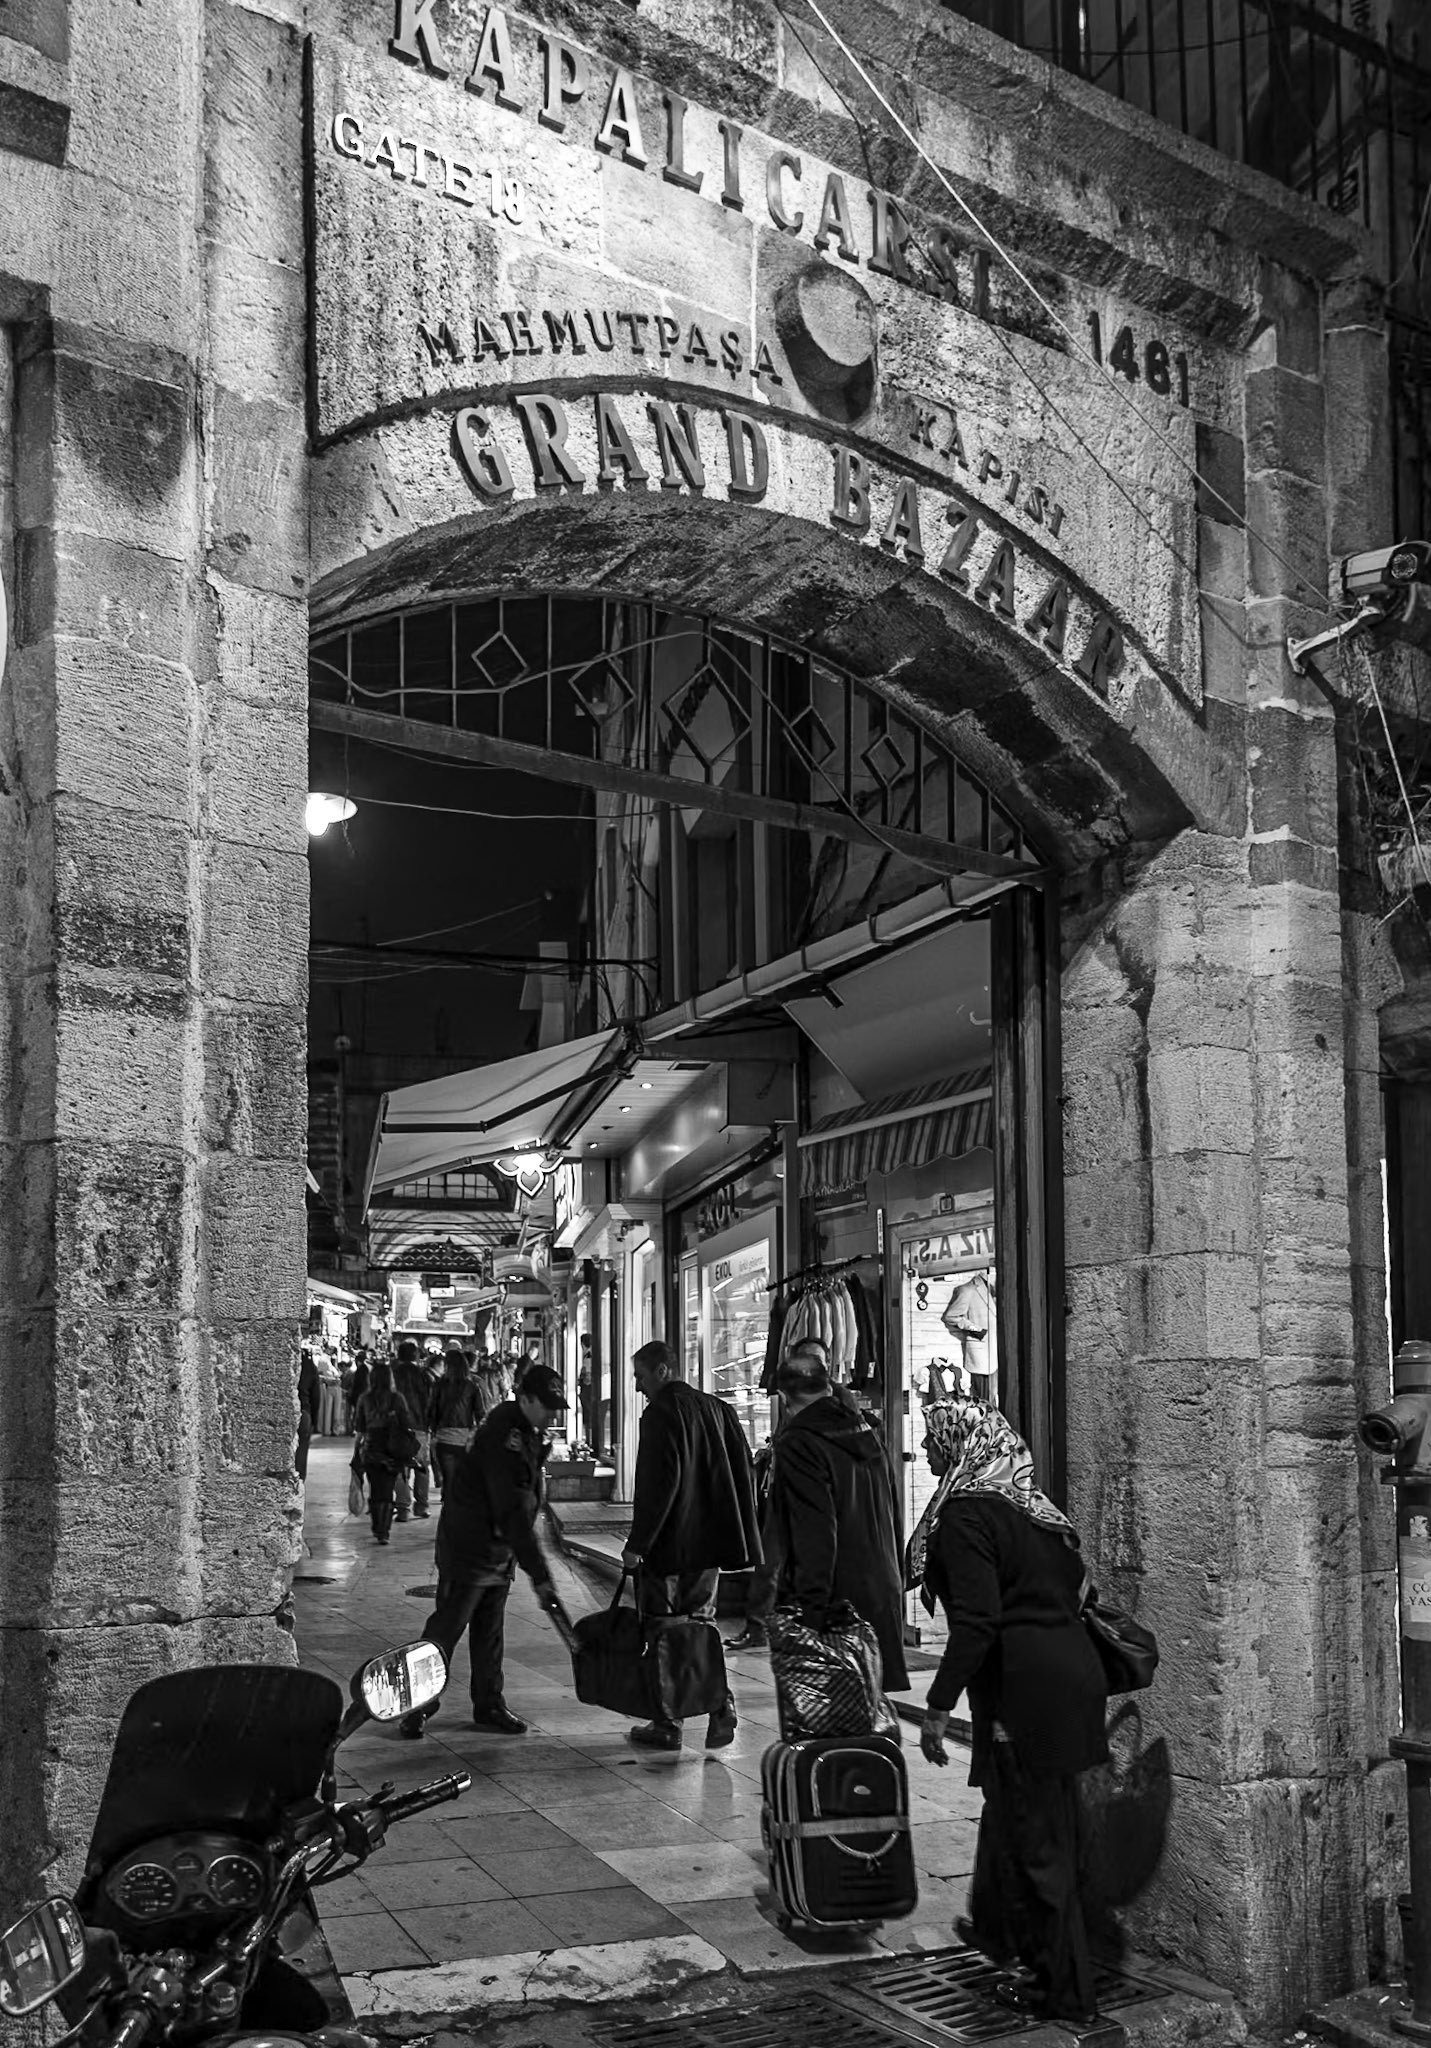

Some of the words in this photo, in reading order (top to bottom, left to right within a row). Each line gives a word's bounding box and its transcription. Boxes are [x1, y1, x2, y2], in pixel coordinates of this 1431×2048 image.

[332, 112, 474, 208] GATE
[483, 168, 526, 226] 18
[1087, 310, 1190, 409] 1481
[450, 392, 769, 504] GRAND
[829, 442, 1130, 706] BAZAAR
